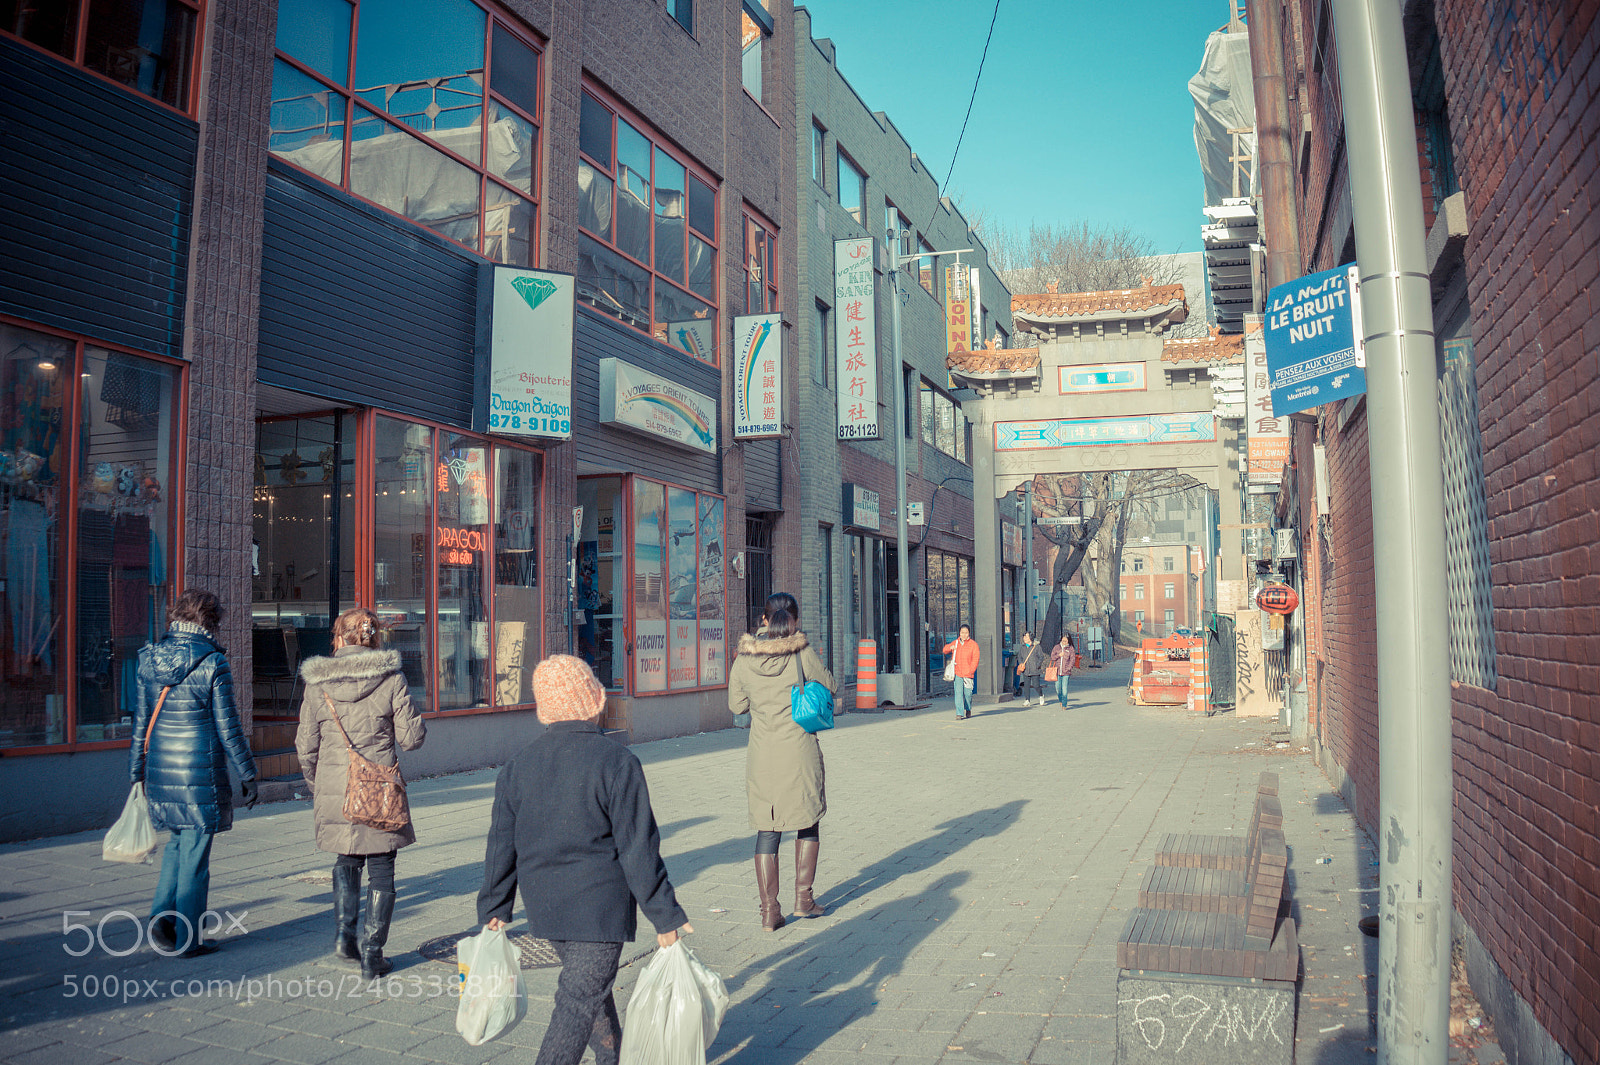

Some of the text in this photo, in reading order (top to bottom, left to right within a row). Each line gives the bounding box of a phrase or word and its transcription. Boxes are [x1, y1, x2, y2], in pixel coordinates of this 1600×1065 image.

[849, 270, 873, 284] KIN
[837, 284, 873, 298] SANG
[1270, 289, 1346, 330] LE BRUIT
[1273, 294, 1294, 312] LA
[1289, 314, 1335, 344] NUIT
[738, 321, 759, 421] VOYAGES ORIENT TOURS
[1275, 365, 1304, 379] PENSEZ
[1304, 361, 1322, 371] AUX
[1322, 349, 1355, 365] VOISINS
[518, 372, 570, 386] Bijouterie
[1287, 389, 1312, 401] Montréal
[491, 392, 570, 418] Dragon Saigon
[627, 384, 710, 426] VOYAGES ORIENT TOURS
[490, 414, 570, 433] 878-9109
[738, 423, 778, 434] 514-879-6962
[1252, 449, 1286, 457] SAI GWAN
[677, 625, 688, 639] VOLS
[700, 628, 723, 640] VOYAGES
[636, 634, 664, 650] CIRCUITS
[680, 647, 686, 660] ET
[708, 648, 716, 660] EN
[640, 658, 661, 673] TOURS
